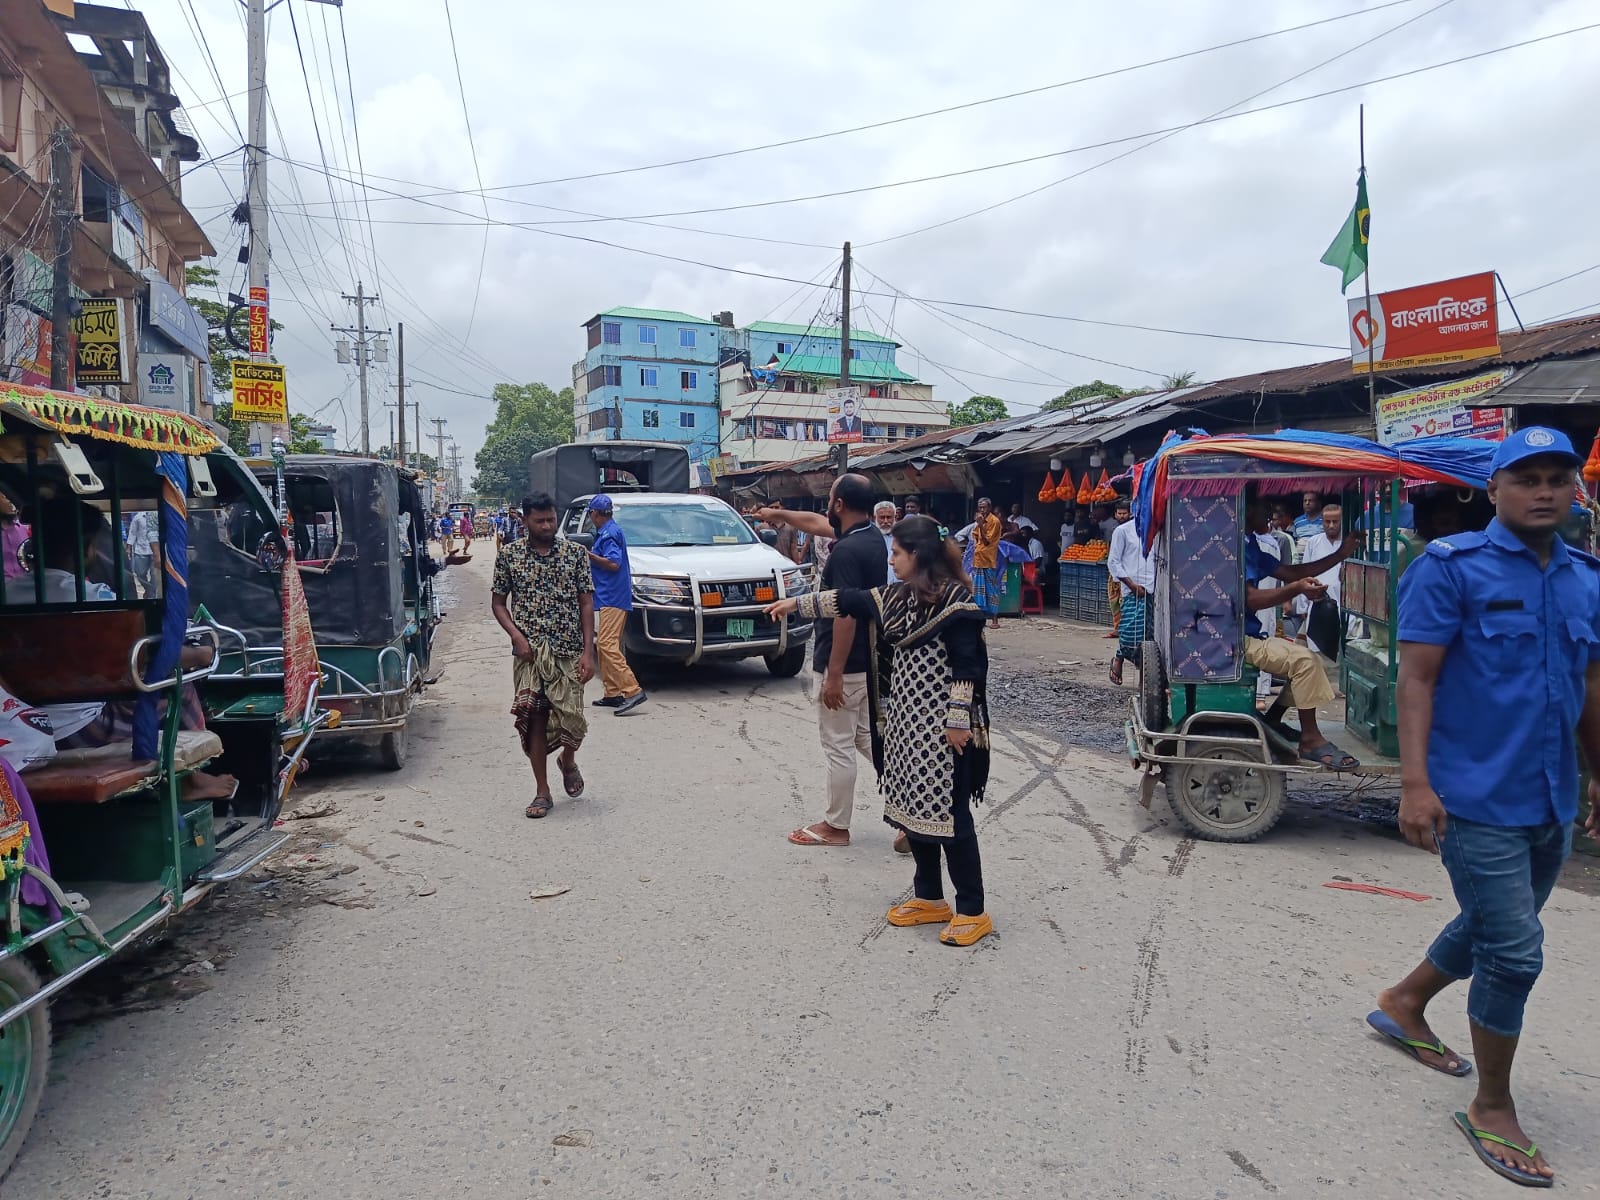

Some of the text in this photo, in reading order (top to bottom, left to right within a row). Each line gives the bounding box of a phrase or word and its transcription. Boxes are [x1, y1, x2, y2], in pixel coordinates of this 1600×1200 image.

[1390, 297, 1488, 328] বাংলালিংক
[1438, 320, 1488, 335] আপনার জন্য
[79, 342, 118, 370] মিষ্টি
[235, 381, 283, 408] নার্সিং
